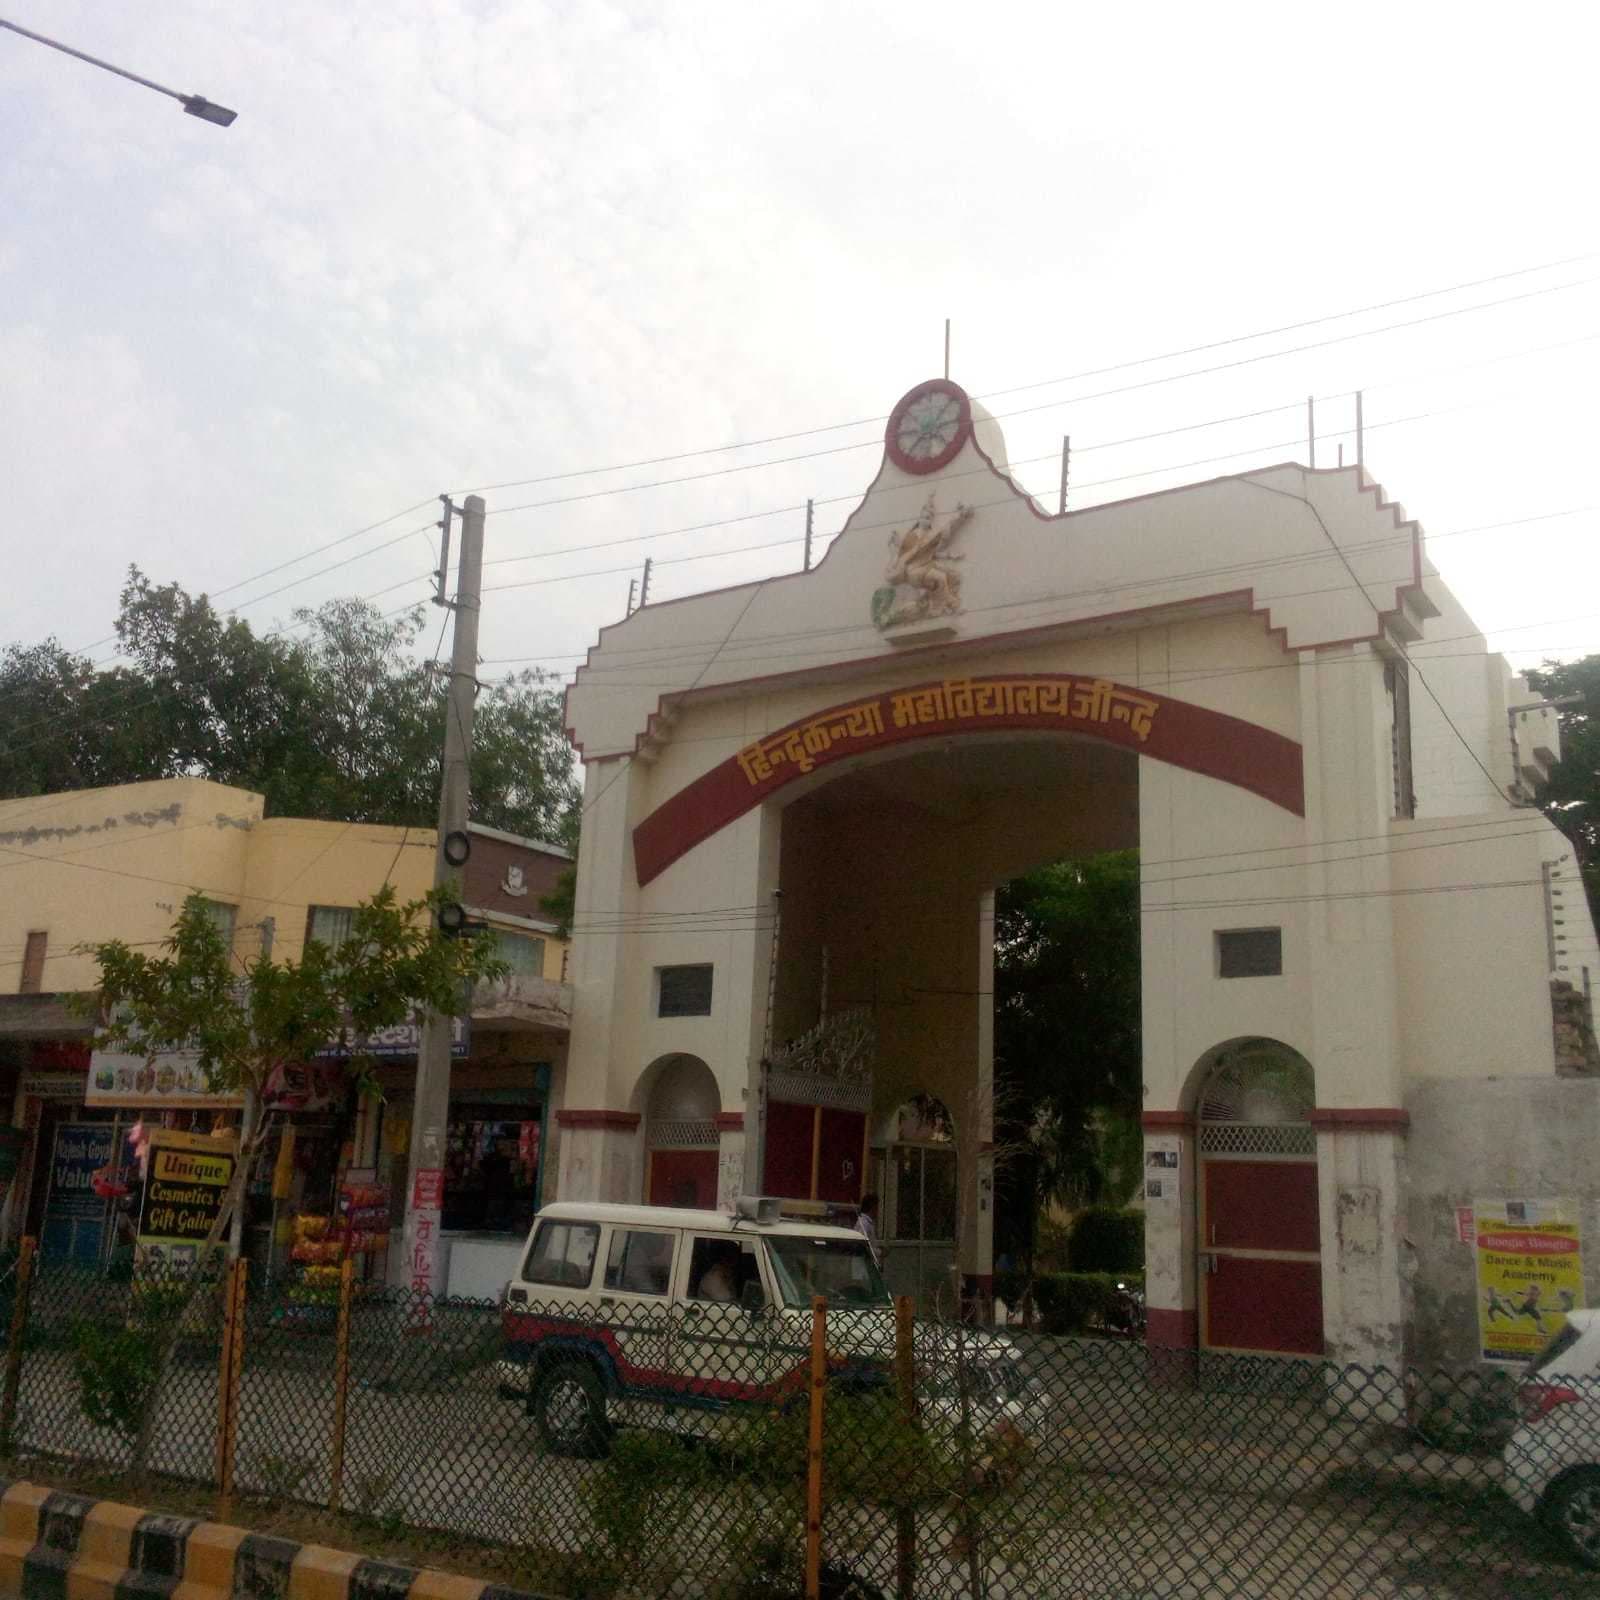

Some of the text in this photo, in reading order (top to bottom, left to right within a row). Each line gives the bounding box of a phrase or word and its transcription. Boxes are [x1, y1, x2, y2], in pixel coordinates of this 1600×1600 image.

[891, 679, 1073, 727] महाविद्यालय
[163, 1154, 224, 1180] Unique
[150, 1182, 213, 1206] Cosmetics
[150, 1208, 176, 1232] Gift
[1486, 1255, 1574, 1269] Dance & Music
[1502, 1269, 1556, 1283] Academy
